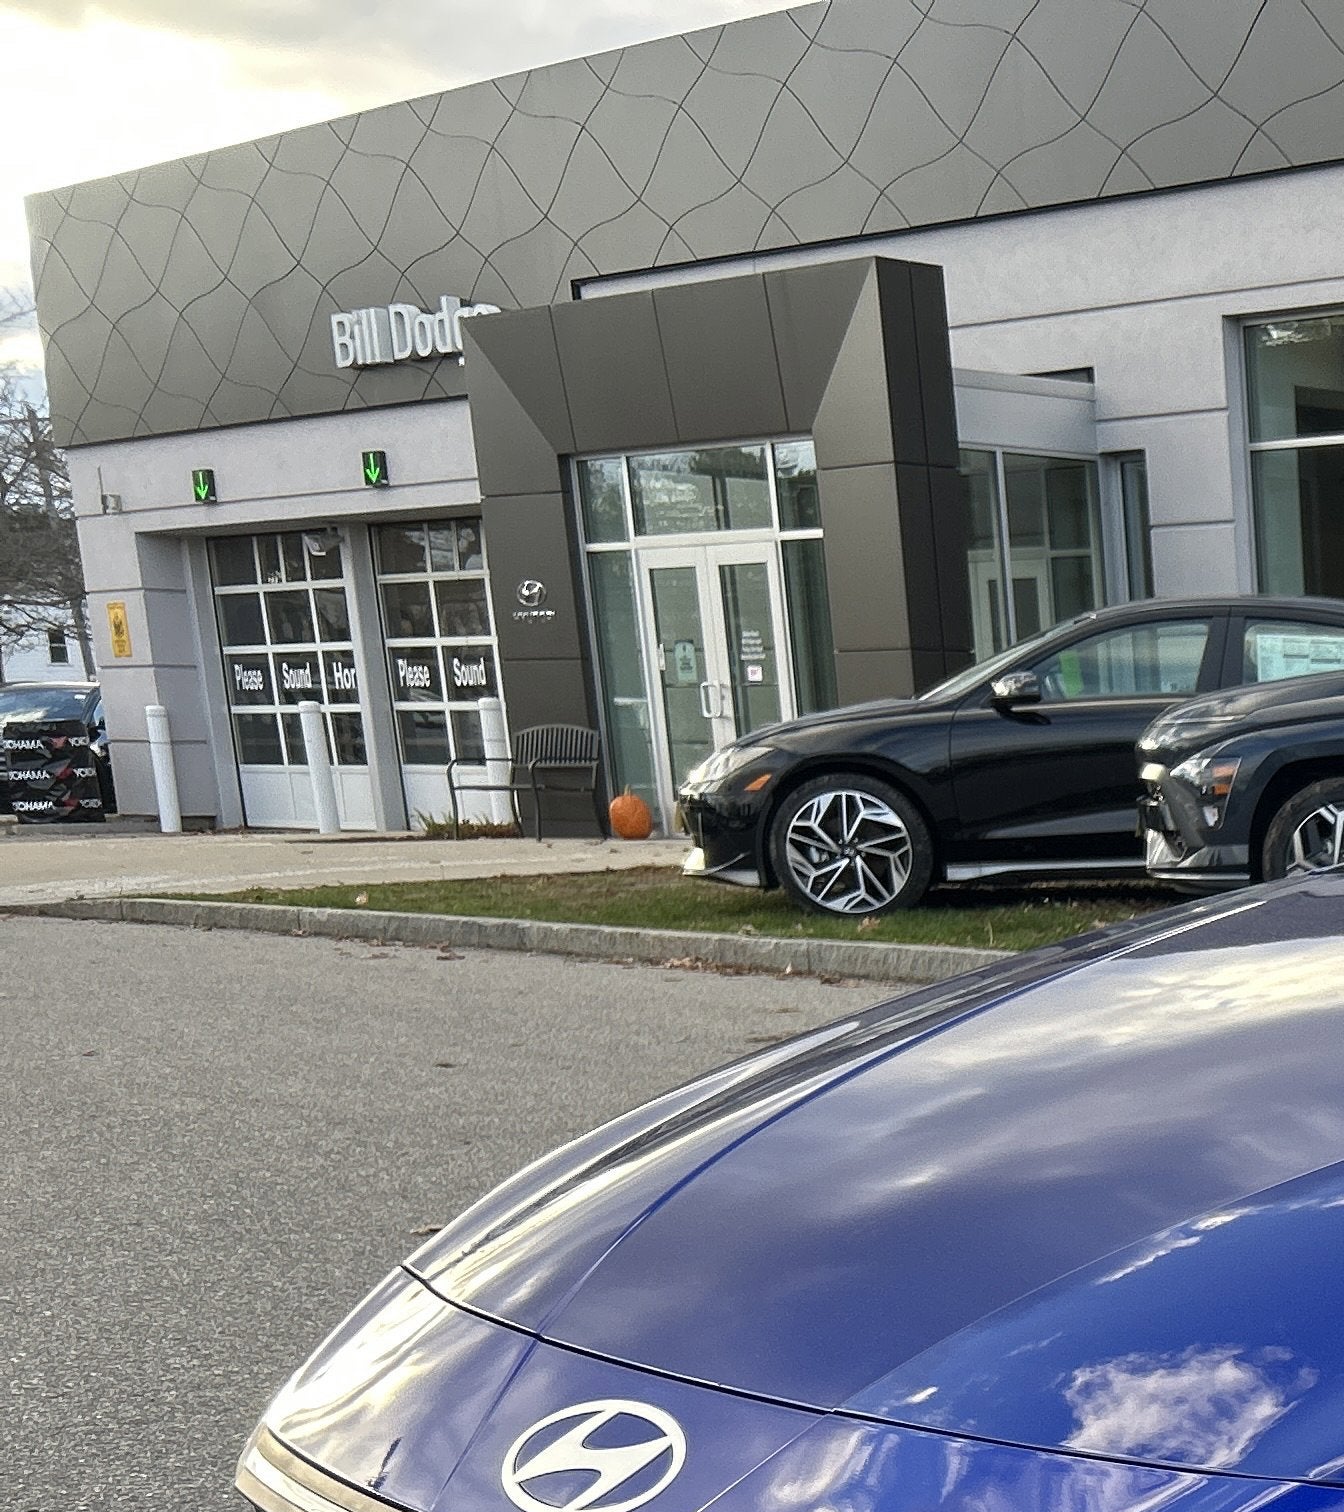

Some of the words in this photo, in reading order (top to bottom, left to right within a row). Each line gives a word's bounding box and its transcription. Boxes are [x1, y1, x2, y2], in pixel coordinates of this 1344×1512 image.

[331, 307, 394, 368] Bill
[389, 295, 501, 366] Dod
[233, 663, 264, 690] Please
[281, 661, 313, 689] Sound
[333, 661, 357, 689] Hor
[397, 658, 431, 687] Please
[453, 656, 487, 687] Sound
